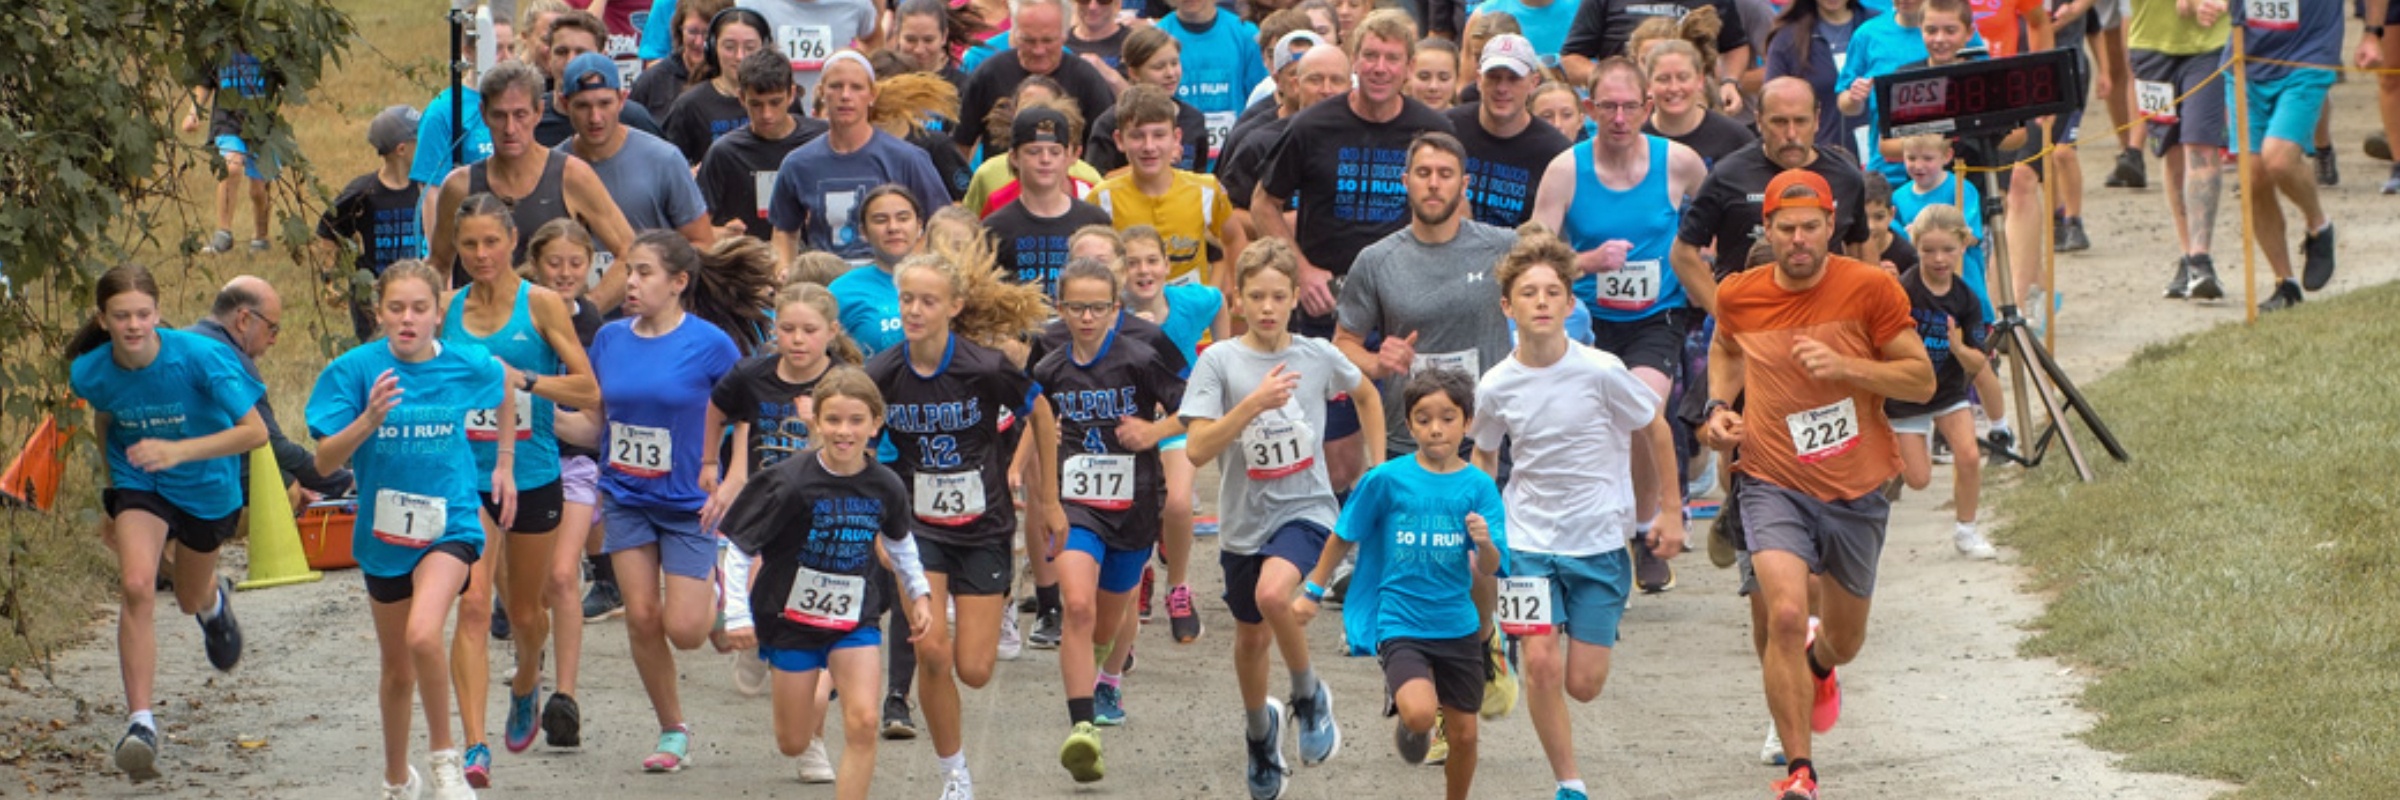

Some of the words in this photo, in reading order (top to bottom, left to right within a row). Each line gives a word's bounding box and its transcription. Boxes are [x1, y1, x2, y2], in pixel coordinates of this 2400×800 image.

[2254, 2, 2290, 19] 335
[788, 40, 825, 58] 196
[1336, 179, 1357, 191] SO
[1361, 179, 1367, 192] I
[1487, 194, 1524, 211] RUN
[1606, 277, 1649, 297] 341
[881, 318, 901, 332] SO
[403, 425, 409, 437] I
[415, 423, 454, 437] RUN
[1082, 426, 1107, 454] 4
[1802, 418, 1849, 450] 222
[618, 439, 661, 467] 213
[918, 434, 962, 468] 12
[1254, 438, 1300, 466] 311
[1073, 472, 1123, 496] 317
[932, 490, 965, 513] 43
[404, 511, 414, 534] 1
[841, 527, 875, 541] RUN
[1397, 531, 1416, 545] SO
[1421, 533, 1427, 546] I
[1433, 533, 1465, 547] RUN
[799, 588, 853, 616] 343
[1499, 596, 1540, 620] 312
